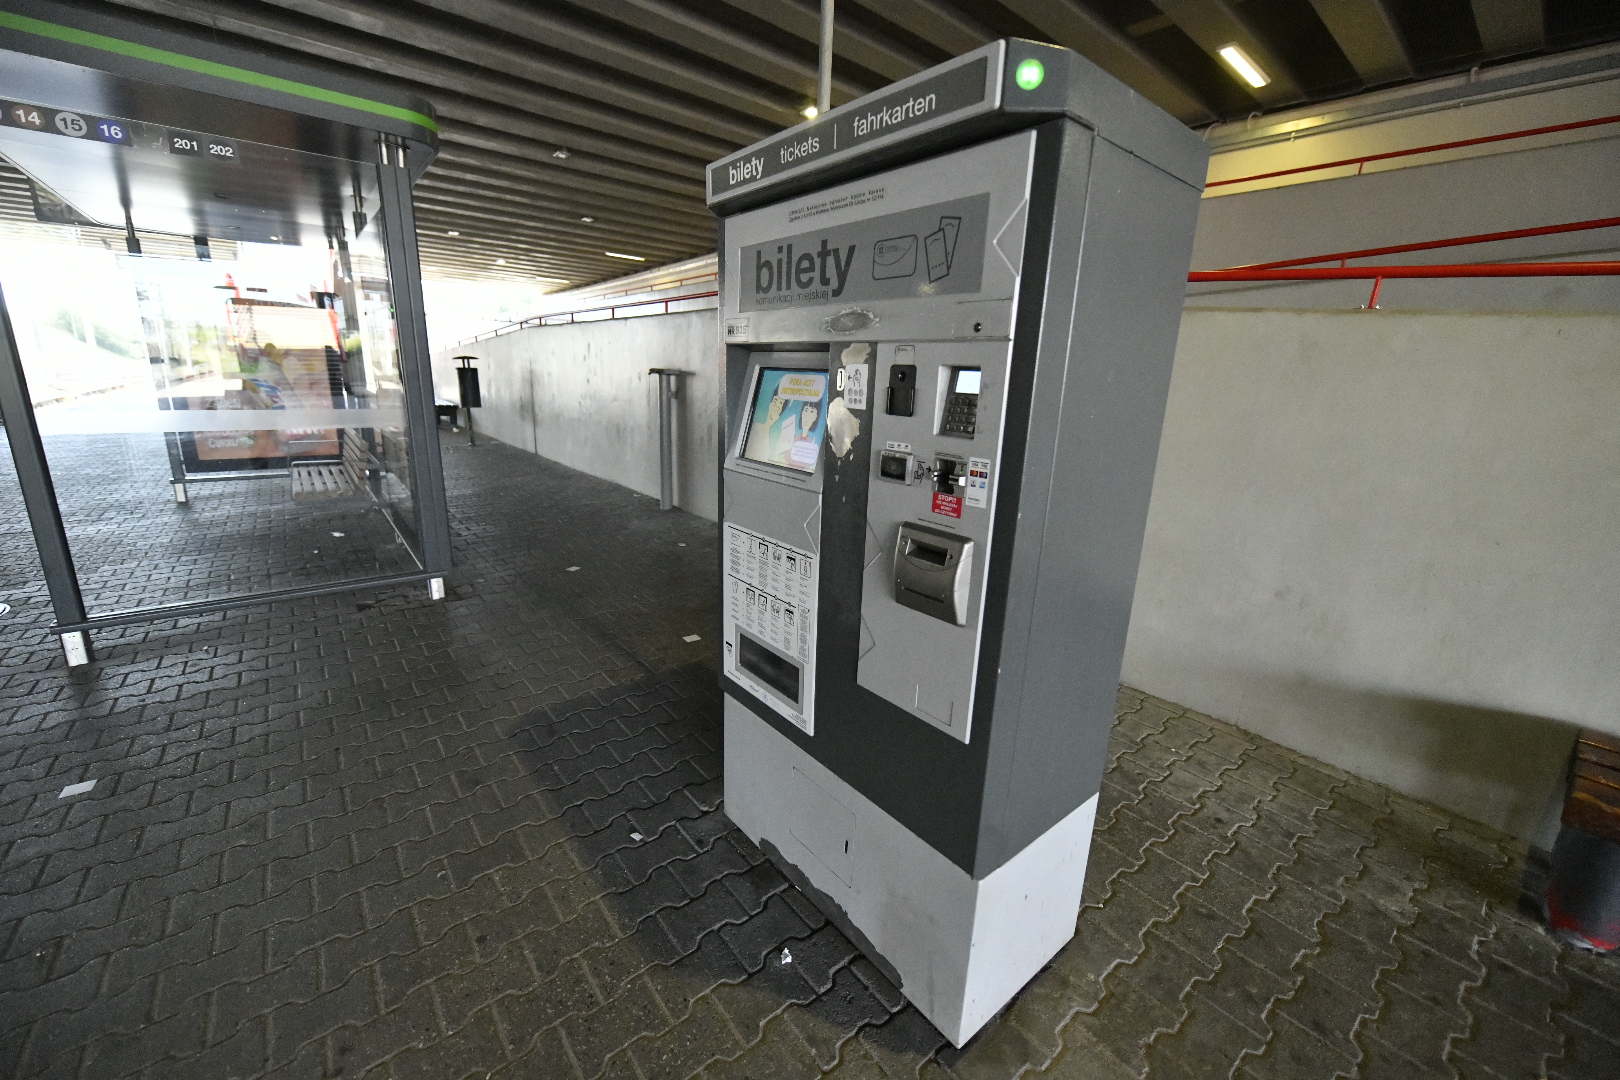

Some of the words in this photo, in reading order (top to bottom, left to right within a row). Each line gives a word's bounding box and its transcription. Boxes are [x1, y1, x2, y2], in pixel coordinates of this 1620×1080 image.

[15, 109, 41, 126] 14
[59, 116, 83, 132] 15
[100, 124, 123, 139] 16
[173, 137, 198, 151] 201
[209, 144, 234, 157] 202
[729, 155, 764, 185] bilety
[780, 134, 820, 164] tickets
[853, 93, 936, 138] fahrkarten
[755, 238, 856, 297] bilety
